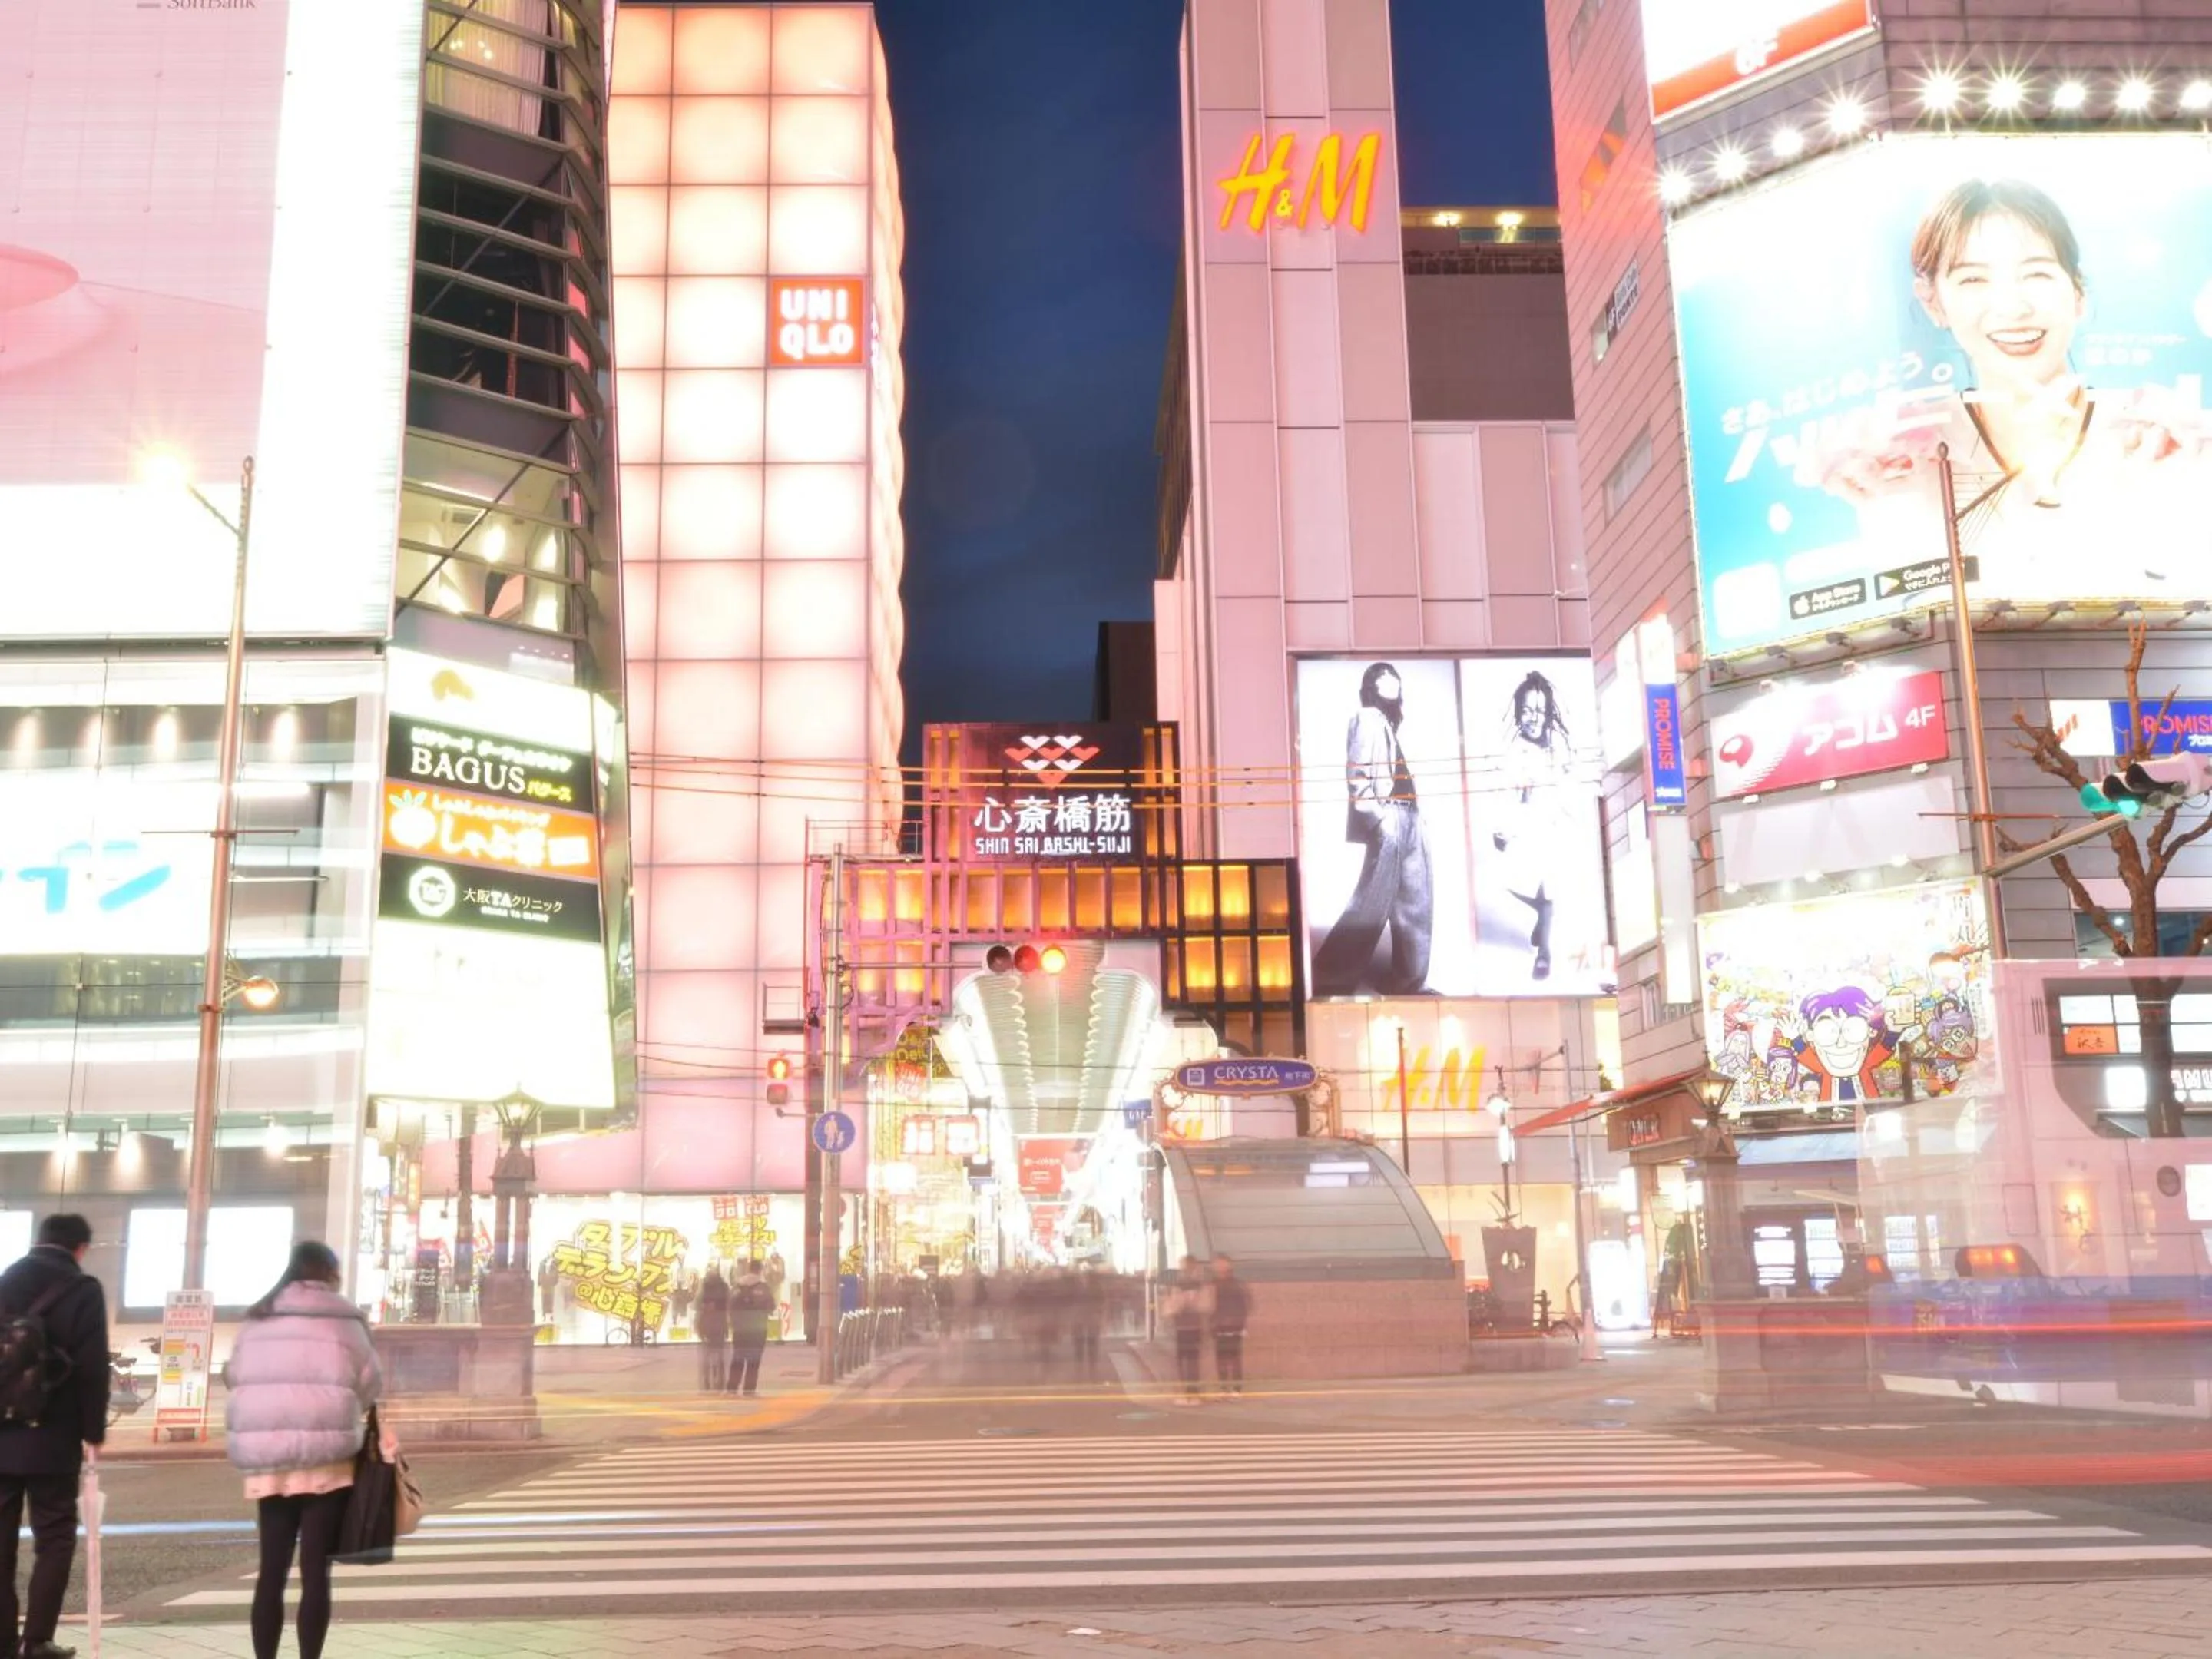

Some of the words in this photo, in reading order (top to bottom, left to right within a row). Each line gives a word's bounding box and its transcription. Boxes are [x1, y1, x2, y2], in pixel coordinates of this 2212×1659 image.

[1217, 131, 1381, 233] H&M
[780, 287, 849, 321] UNI
[780, 323, 854, 360] QLO
[1654, 697, 1676, 770] PROMISE
[1803, 714, 1899, 757] アコム
[1904, 704, 1936, 728] 4F
[410, 746, 528, 794] BAGUS
[973, 793, 1132, 833] 心斎橋筋
[975, 837, 1009, 855] SHIN
[1015, 836, 1039, 854] SAI
[1214, 1065, 1279, 1080] CRYSTA
